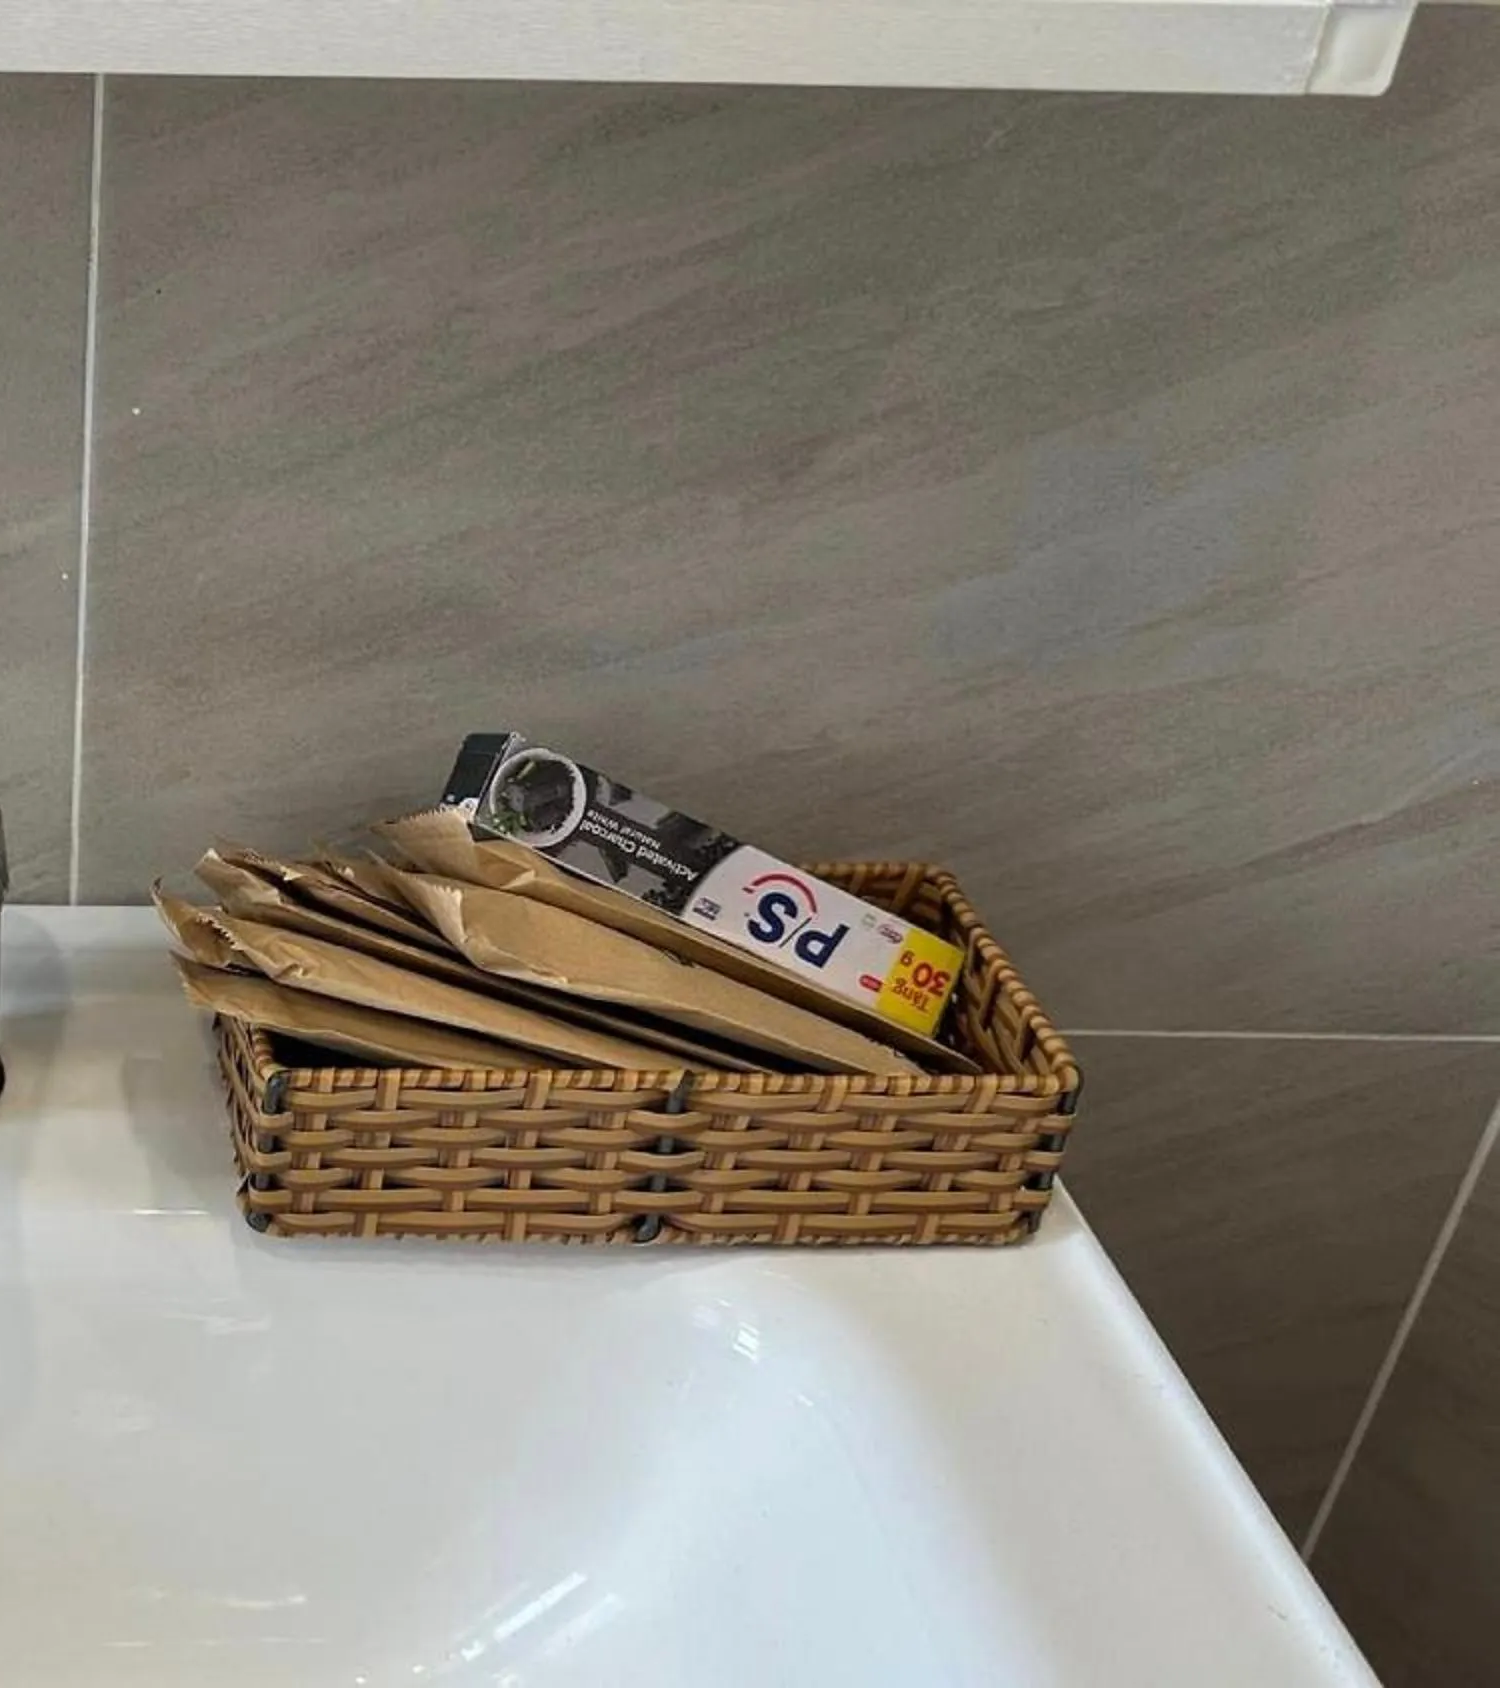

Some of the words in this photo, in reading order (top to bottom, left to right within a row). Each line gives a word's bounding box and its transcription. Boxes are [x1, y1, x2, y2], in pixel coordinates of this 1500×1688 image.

[579, 819, 638, 853] Charcoal
[586, 809, 619, 831] White
[619, 825, 662, 850] Natural
[635, 846, 700, 882] Activated
[747, 892, 851, 970] P/S
[913, 961, 951, 998] 30
